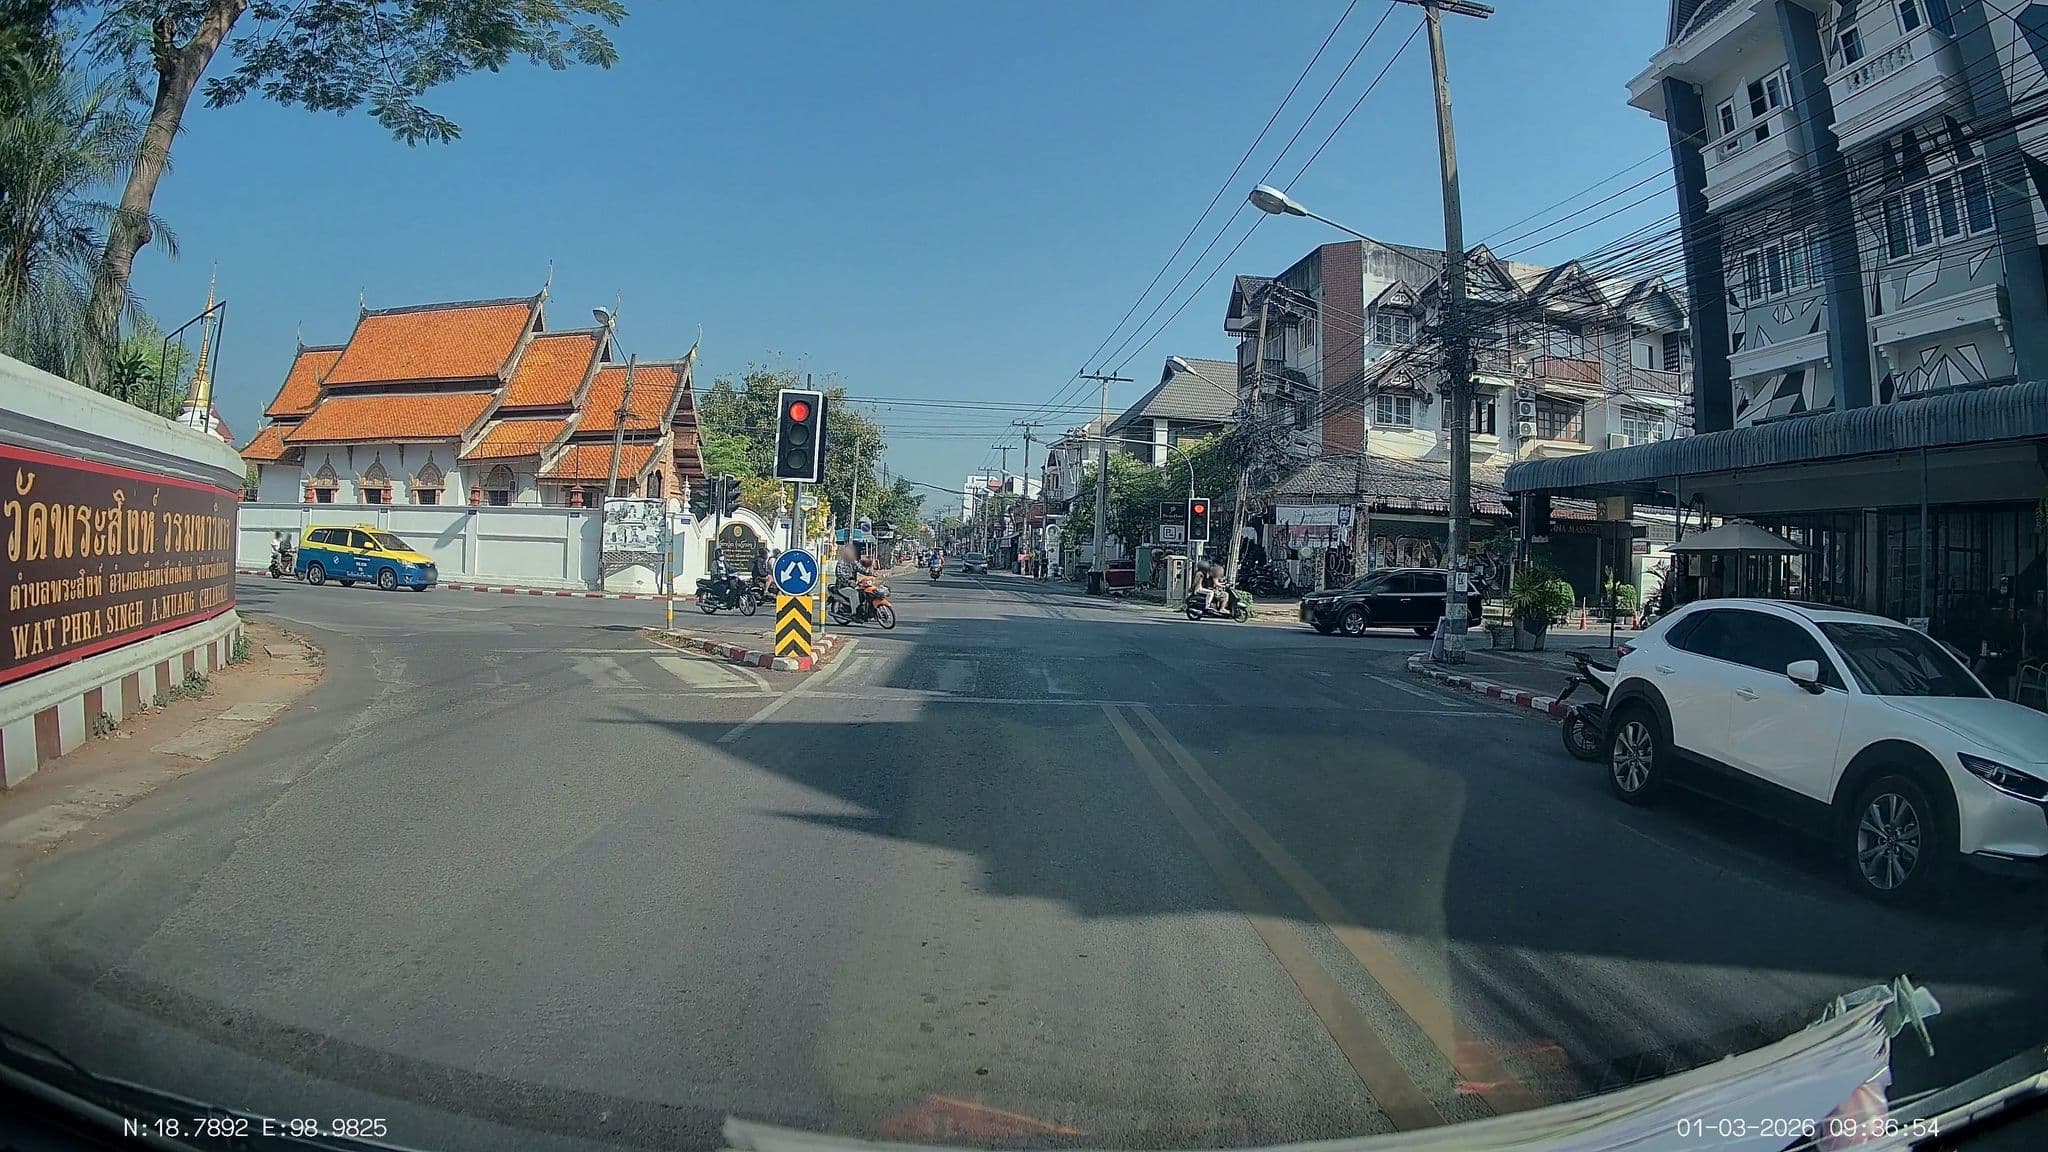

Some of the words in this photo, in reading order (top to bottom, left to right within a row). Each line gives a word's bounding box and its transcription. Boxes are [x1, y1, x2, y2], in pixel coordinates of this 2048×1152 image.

[4, 467, 160, 563] วัดพระสิงห์
[163, 503, 231, 553] วรมหาวิหาร
[10, 563, 104, 611] ตำบลพระสิงห์
[11, 621, 56, 660] WAT
[61, 609, 102, 646] PHRA
[106, 600, 144, 633] SINGH
[150, 590, 195, 622] A.MUANG
